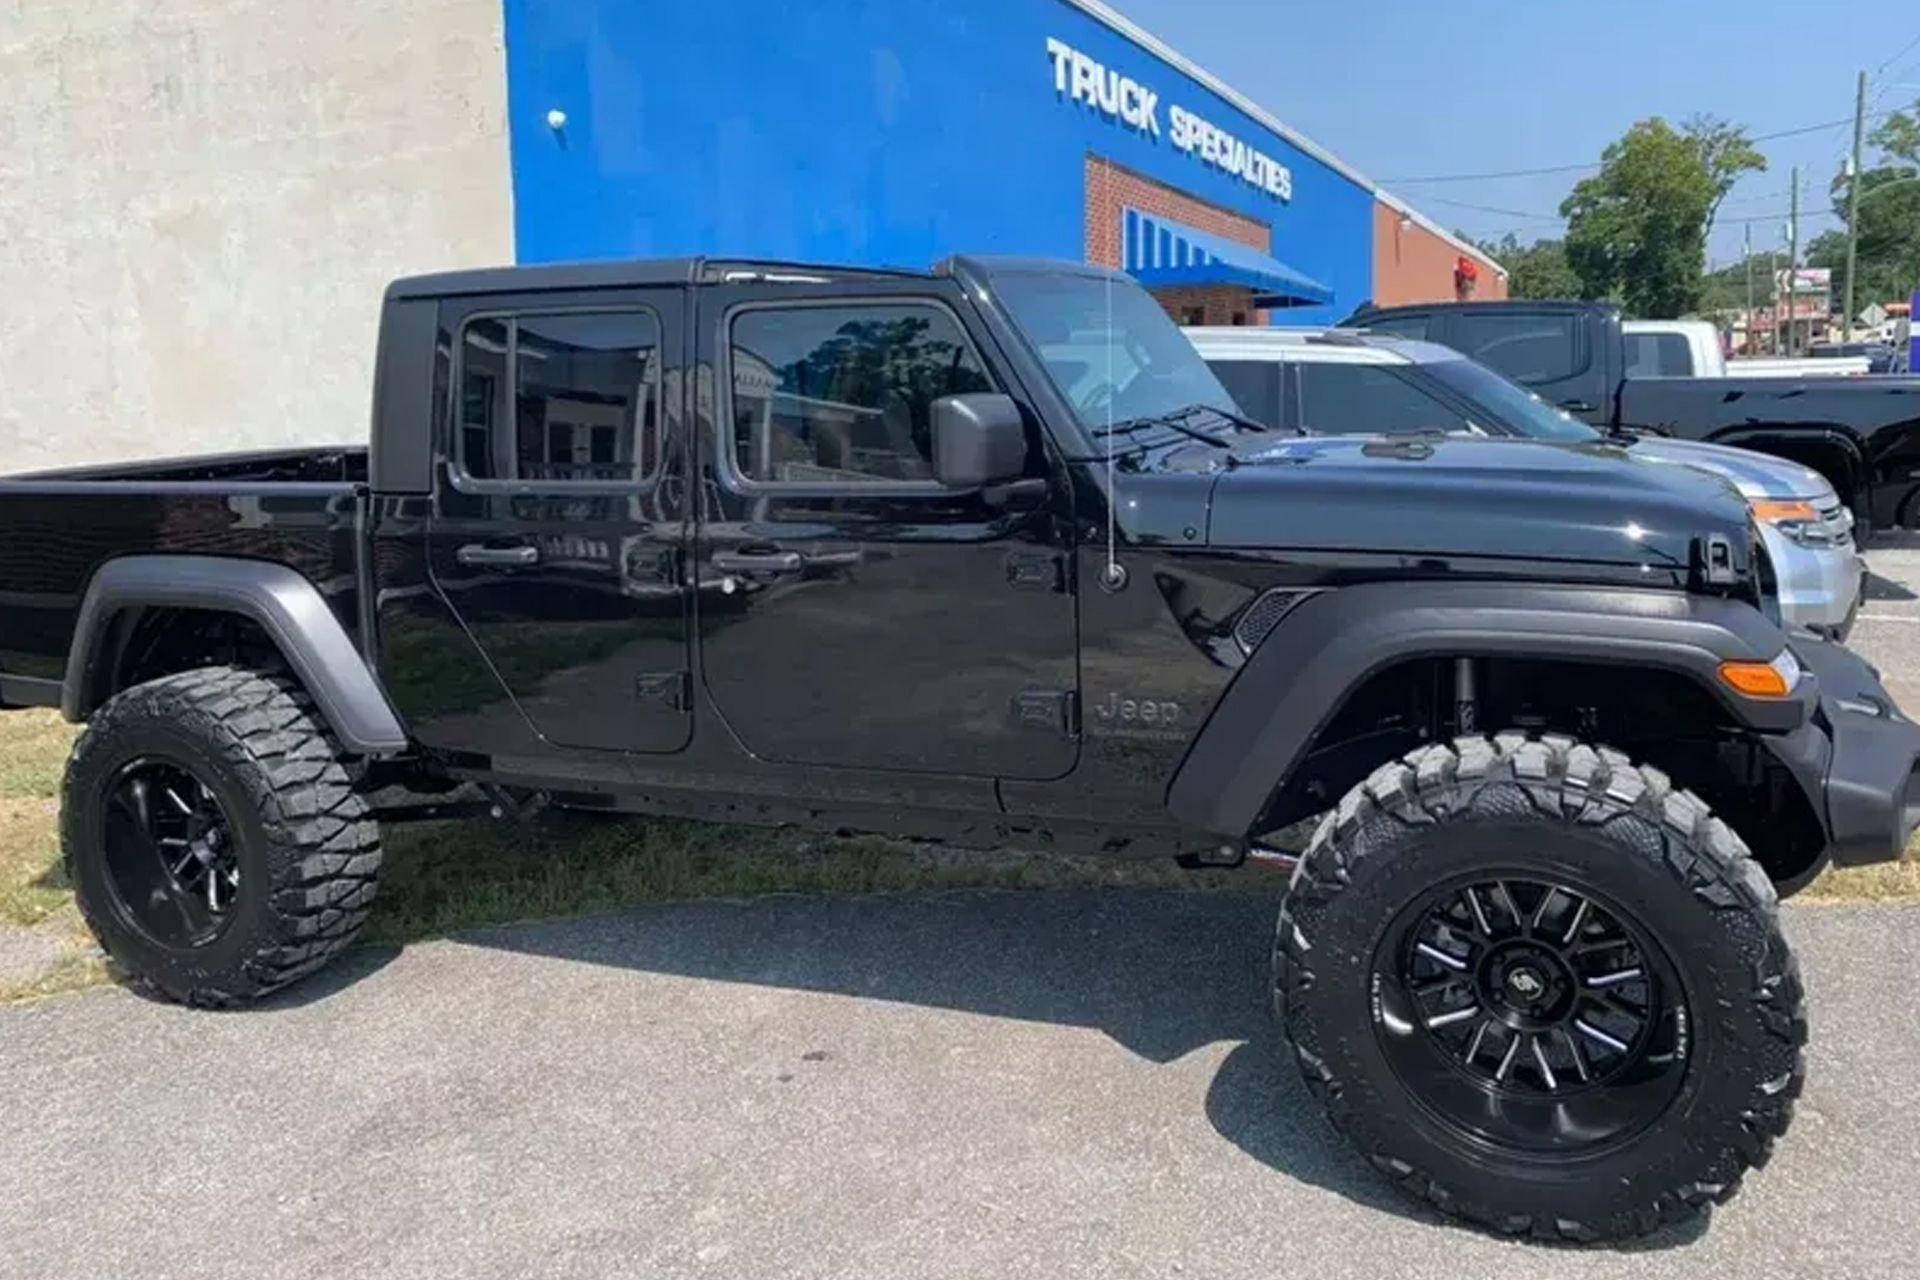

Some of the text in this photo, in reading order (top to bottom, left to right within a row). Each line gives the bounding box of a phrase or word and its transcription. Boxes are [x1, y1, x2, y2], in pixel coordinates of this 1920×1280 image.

[1046, 36, 1292, 200] TRUCK SPECIALTIES
[1095, 692, 1180, 726] Jeep
